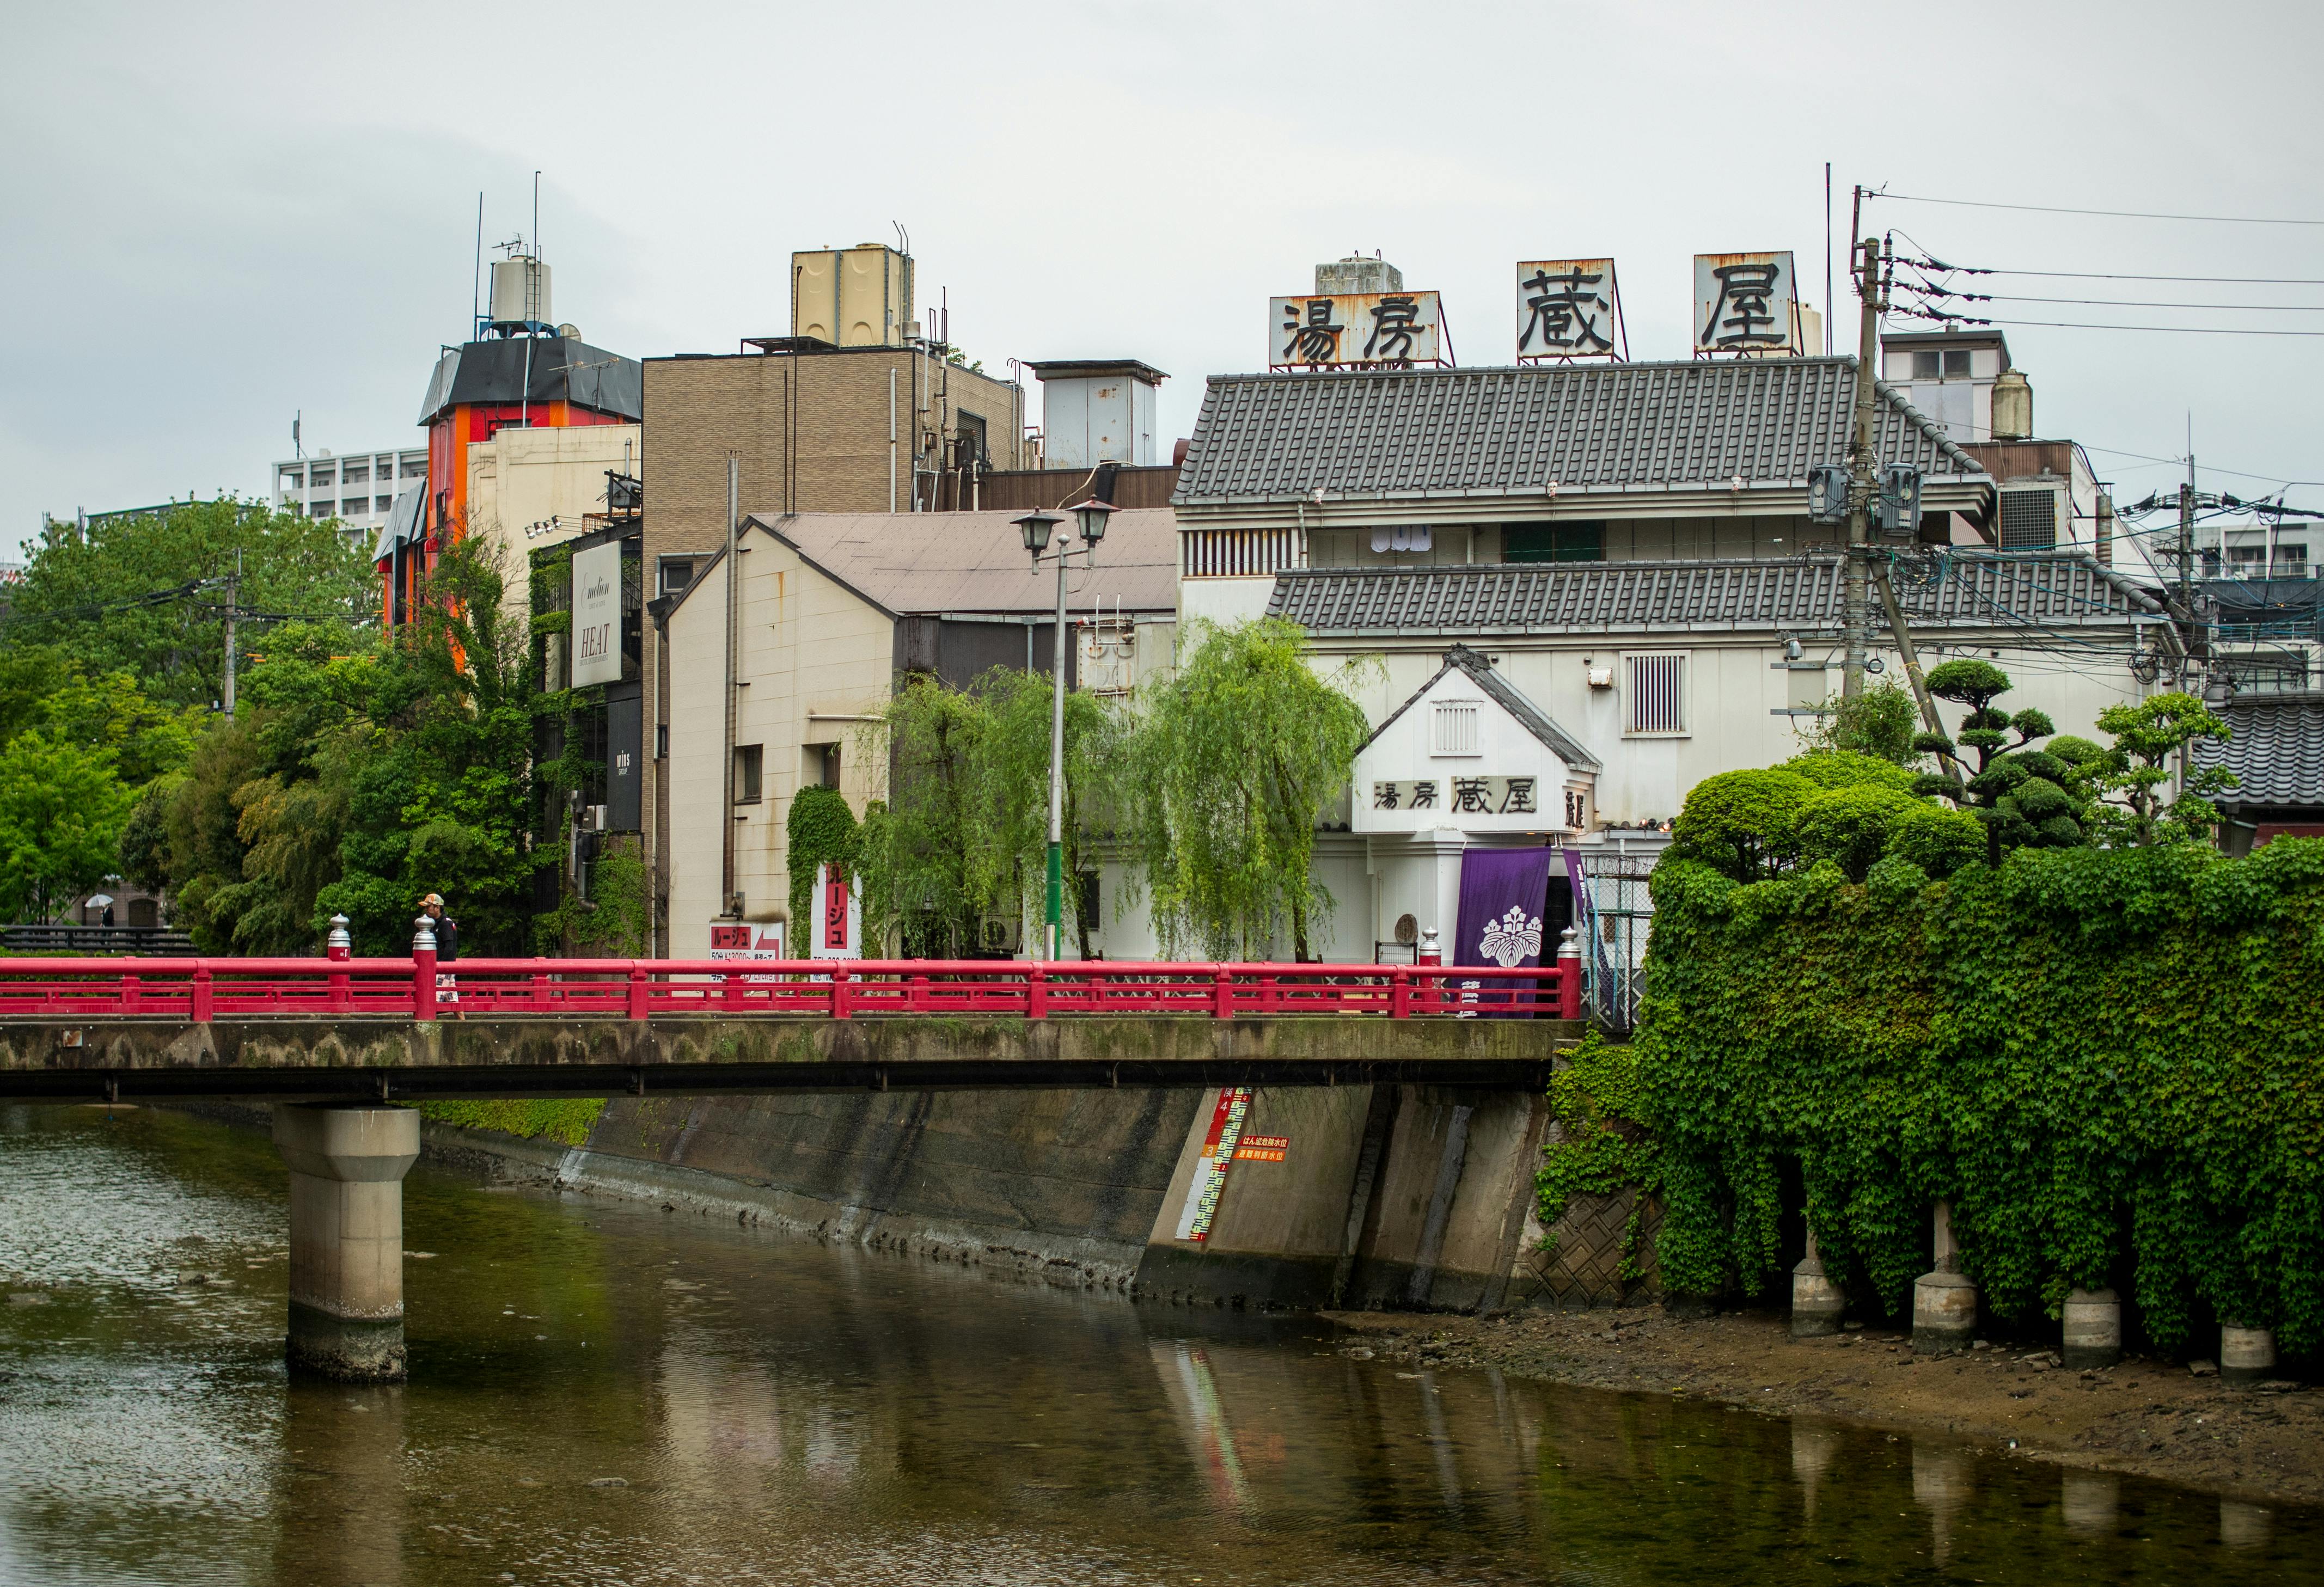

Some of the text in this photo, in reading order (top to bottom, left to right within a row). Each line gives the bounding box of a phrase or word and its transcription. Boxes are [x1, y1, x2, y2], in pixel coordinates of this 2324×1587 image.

[1283, 263, 1787, 361] 湯房 蔵 屋
[580, 572, 609, 609] Emotion
[581, 623, 610, 658] HEAT
[616, 750, 630, 767] wins
[1374, 777, 1537, 813] 湯房 蔵屋
[714, 928, 748, 946] ルージュ
[1220, 1101, 1227, 1111] 4
[1243, 1137, 1287, 1147] はん濫危険水位
[1206, 1146, 1213, 1156] 3
[1239, 1149, 1283, 1160] 避難判断水位
